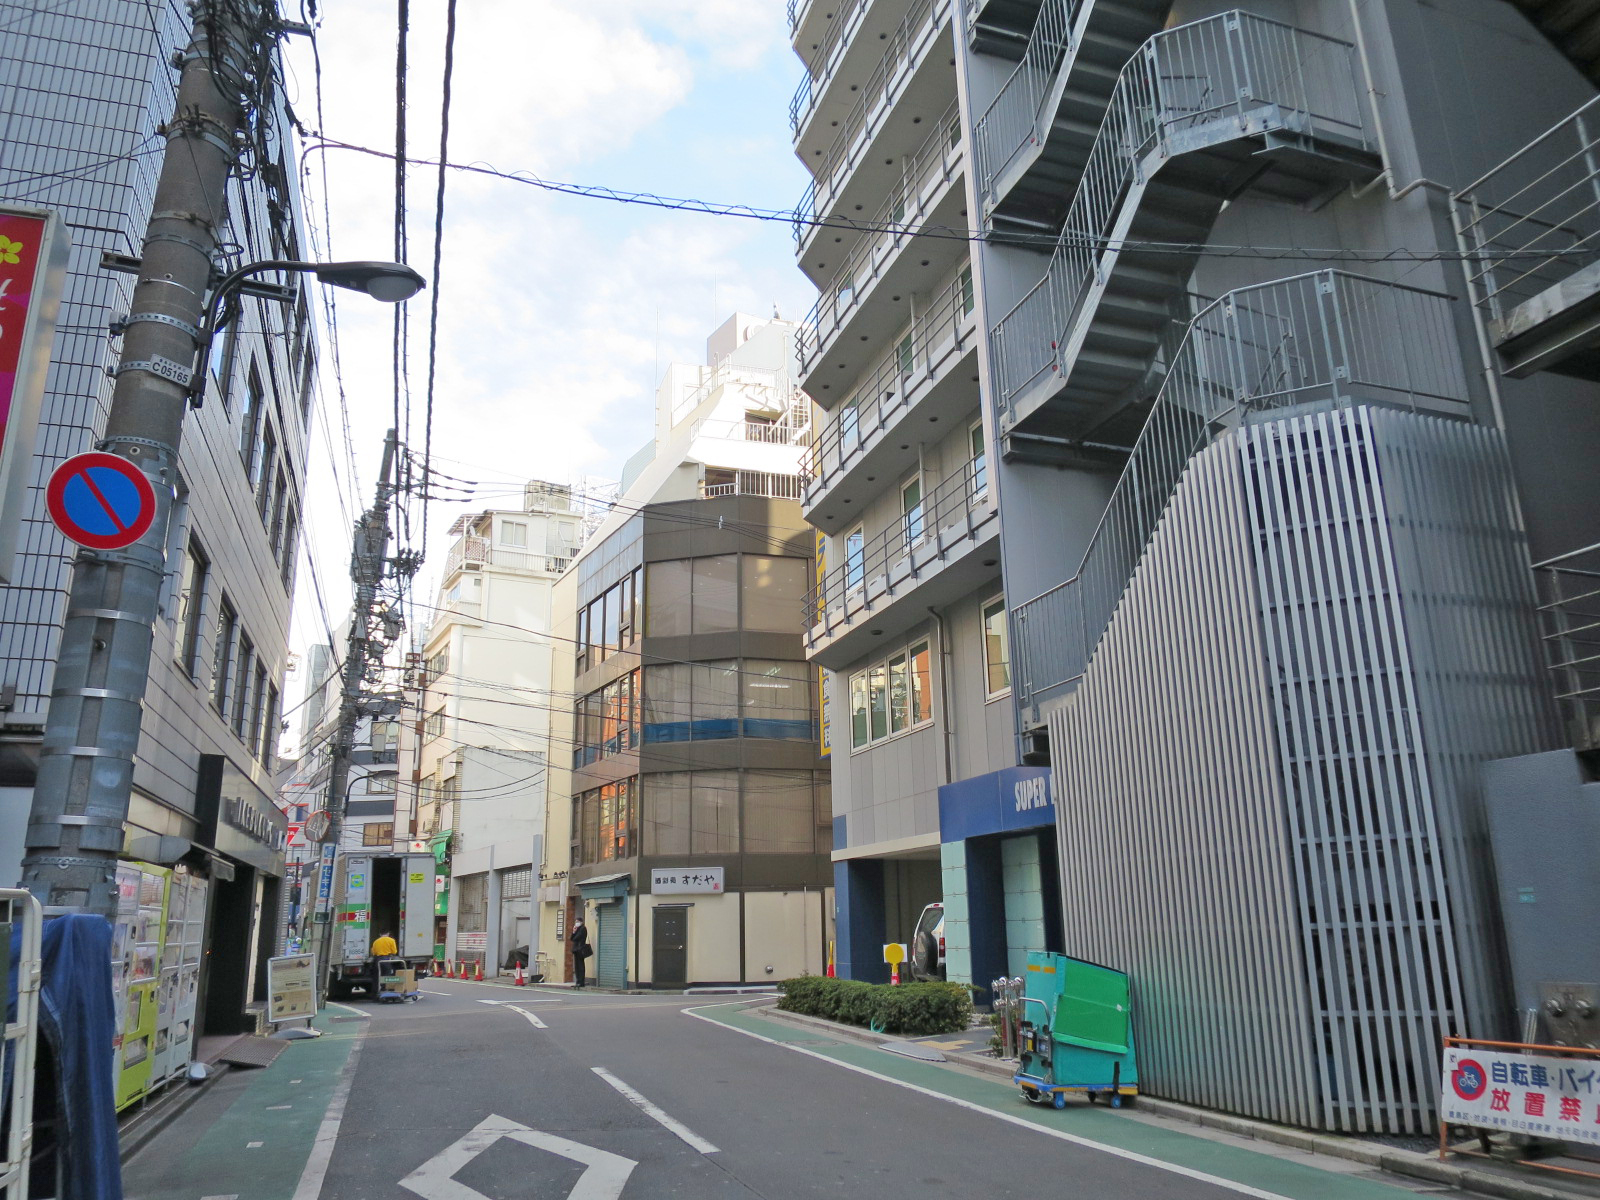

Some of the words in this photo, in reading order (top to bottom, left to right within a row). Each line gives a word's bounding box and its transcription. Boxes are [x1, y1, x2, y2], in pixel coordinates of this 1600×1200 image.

[152, 362, 189, 384] C05165
[1014, 776, 1048, 812] SUPER
[681, 874, 715, 886] すだや
[354, 909, 367, 923] 福
[1491, 1060, 1600, 1096] 自転車・バイ
